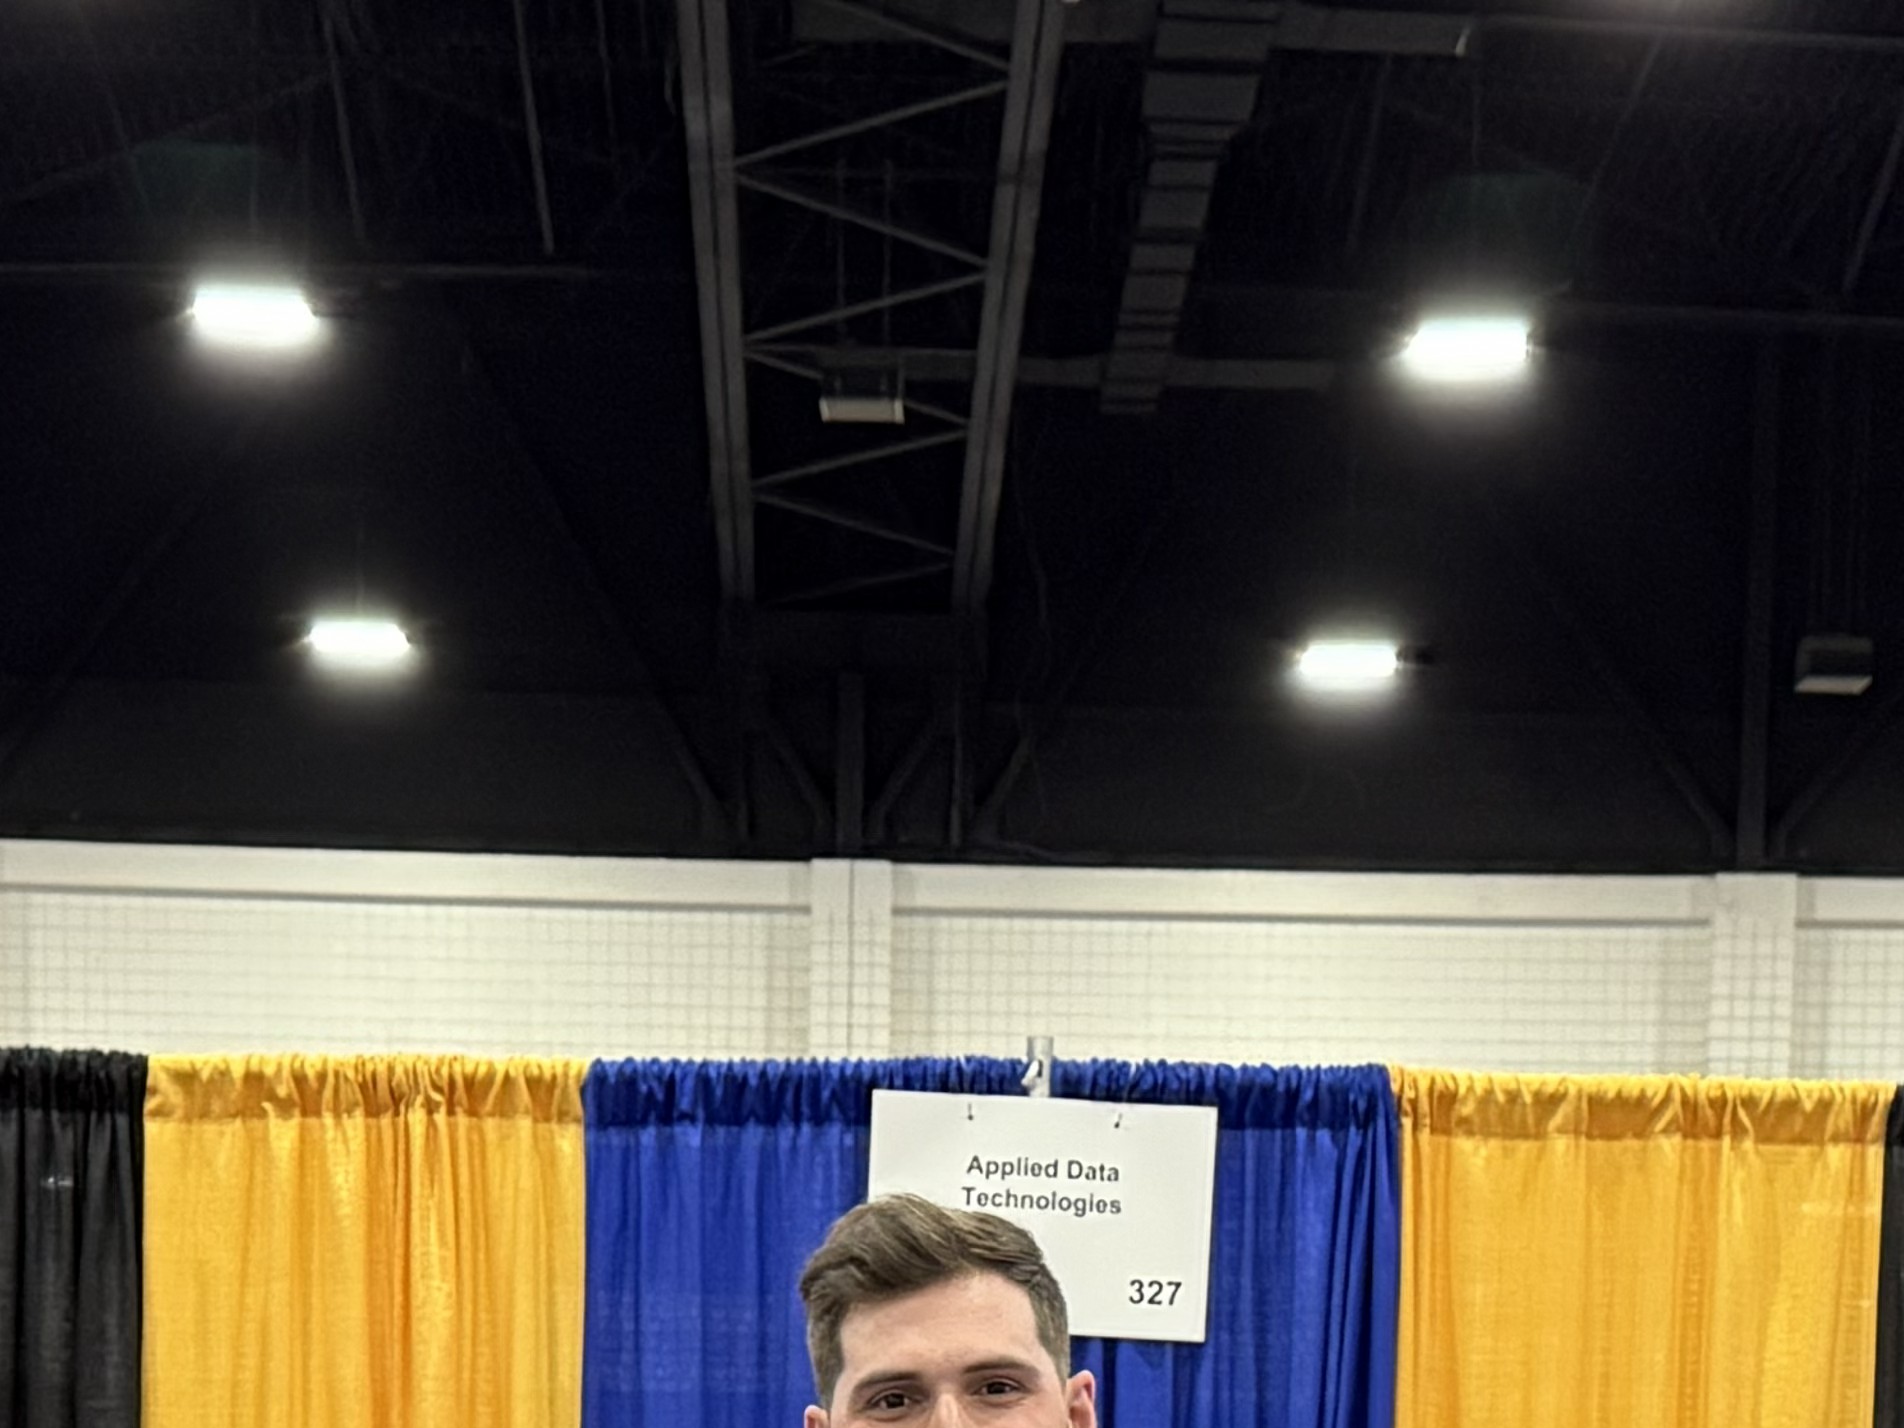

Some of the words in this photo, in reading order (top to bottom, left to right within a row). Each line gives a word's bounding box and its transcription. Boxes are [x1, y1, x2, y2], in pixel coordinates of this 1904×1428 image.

[966, 1155, 1058, 1181] Applied
[1067, 1160, 1120, 1182] Data
[962, 1186, 1122, 1217] Technologies
[1128, 1279, 1182, 1305] 327
